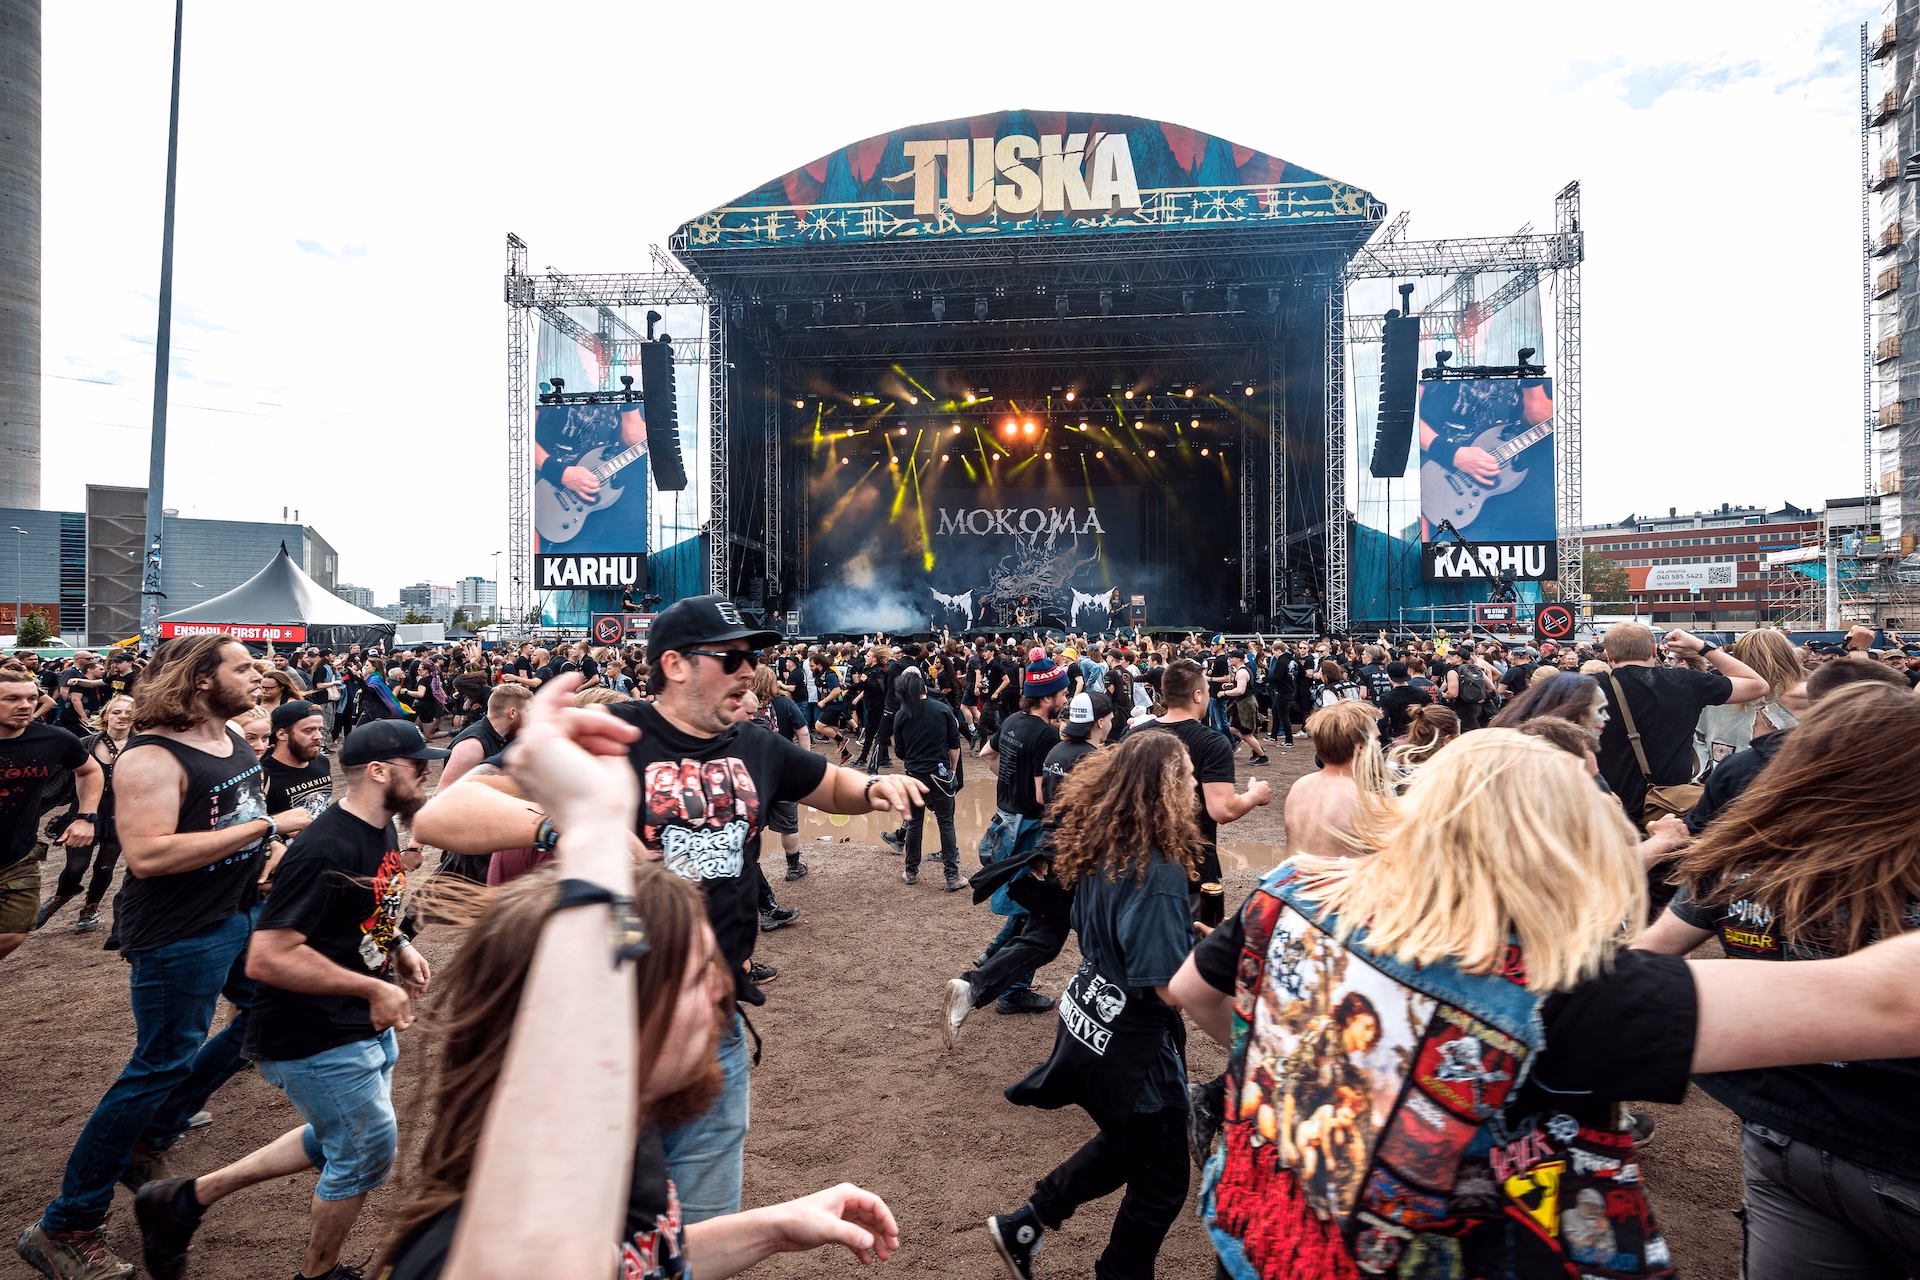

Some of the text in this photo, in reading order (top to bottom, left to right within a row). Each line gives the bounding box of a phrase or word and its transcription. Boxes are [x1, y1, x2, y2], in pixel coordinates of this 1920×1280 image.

[902, 132, 1142, 222] TUSKA
[936, 506, 1106, 537] MOKOMA
[543, 556, 638, 586] KARHU
[1434, 544, 1546, 578] KARHU
[231, 627, 261, 638] FIRST
[262, 628, 280, 639] AID
